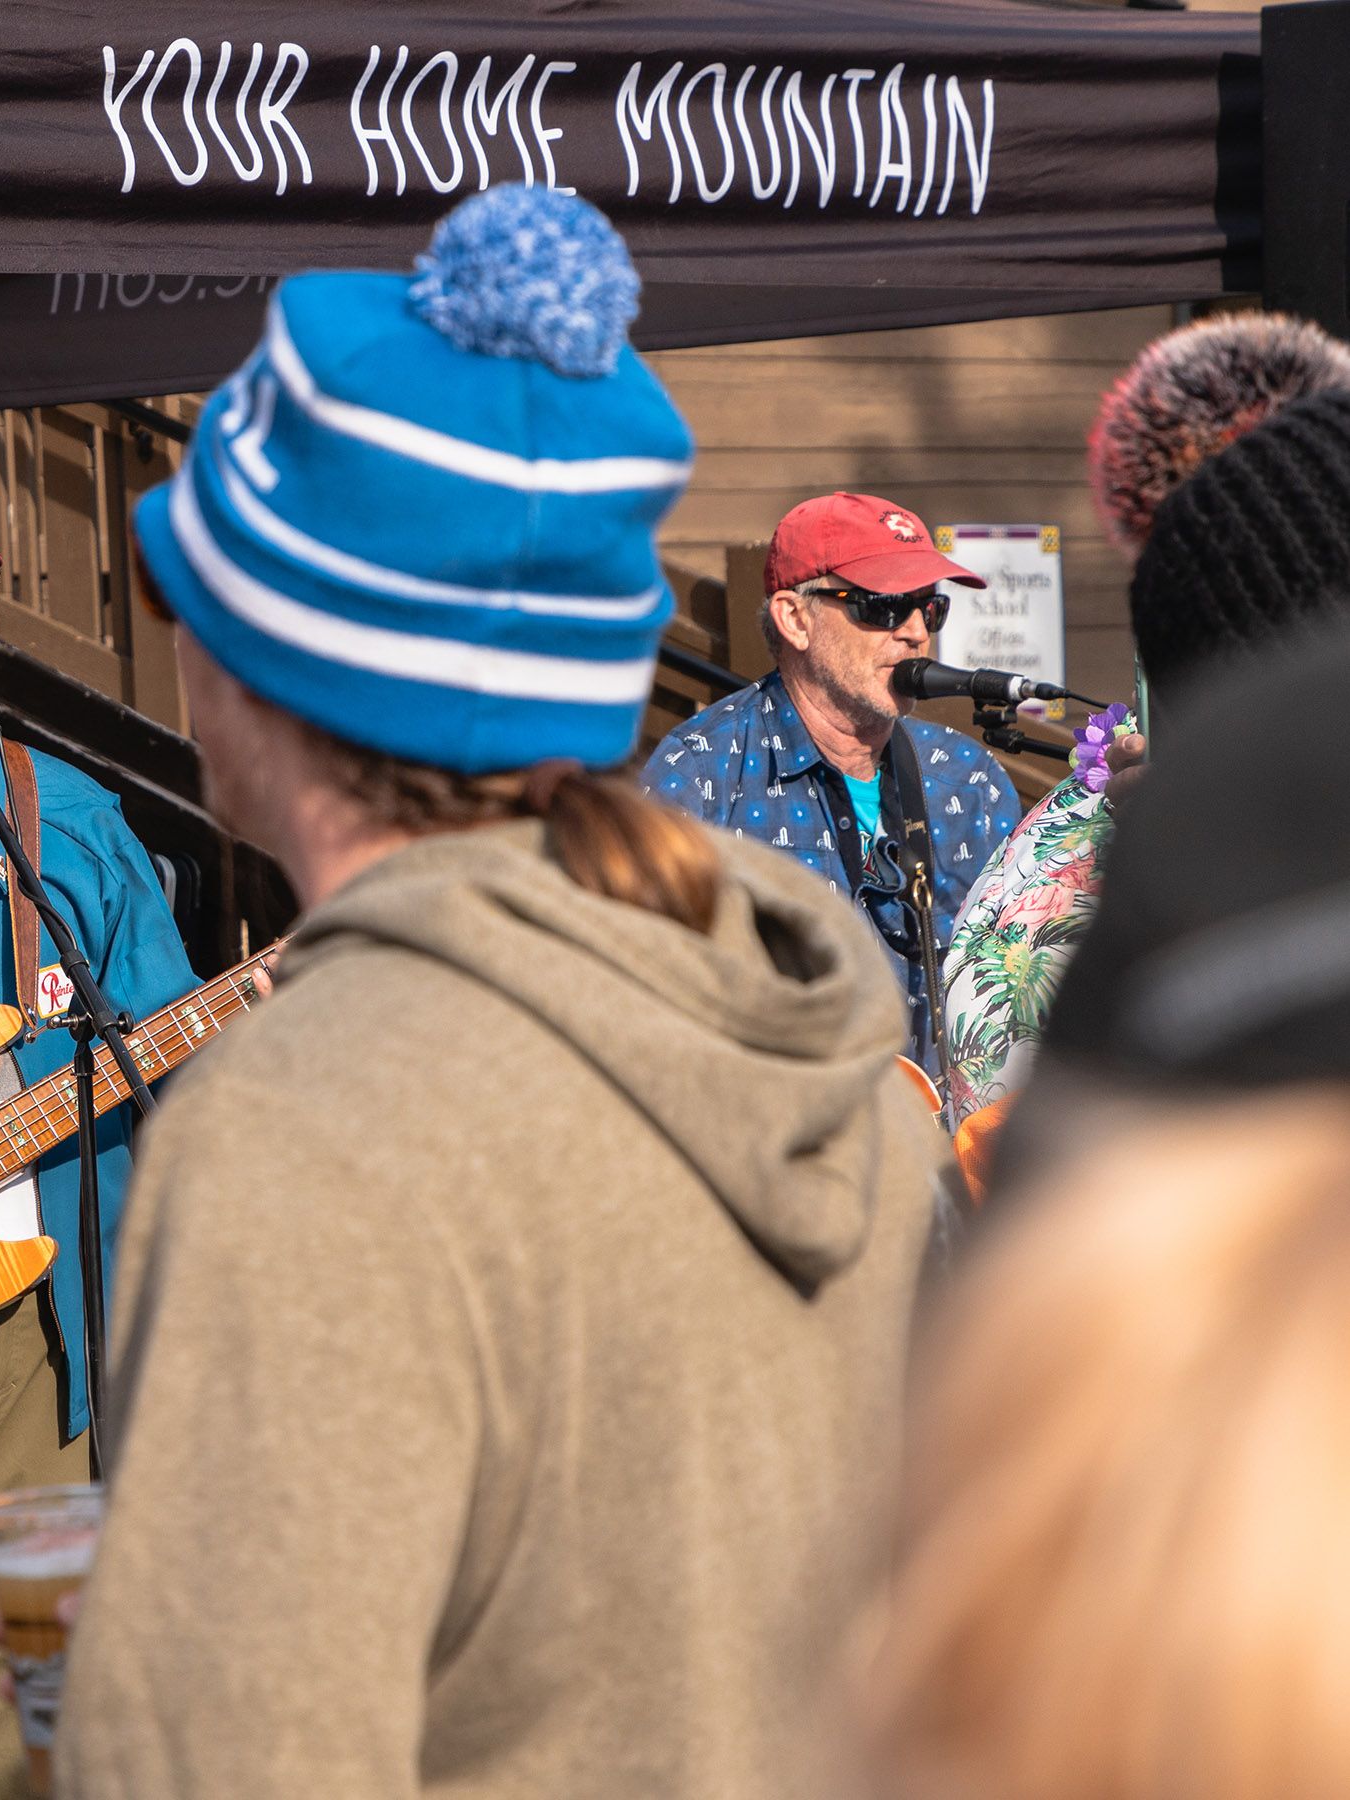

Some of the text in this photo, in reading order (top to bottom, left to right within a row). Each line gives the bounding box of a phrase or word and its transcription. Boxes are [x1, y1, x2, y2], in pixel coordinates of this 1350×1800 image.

[103, 38, 995, 217] YOUR HOME MOUNTAIN
[970, 593, 1030, 616] School
